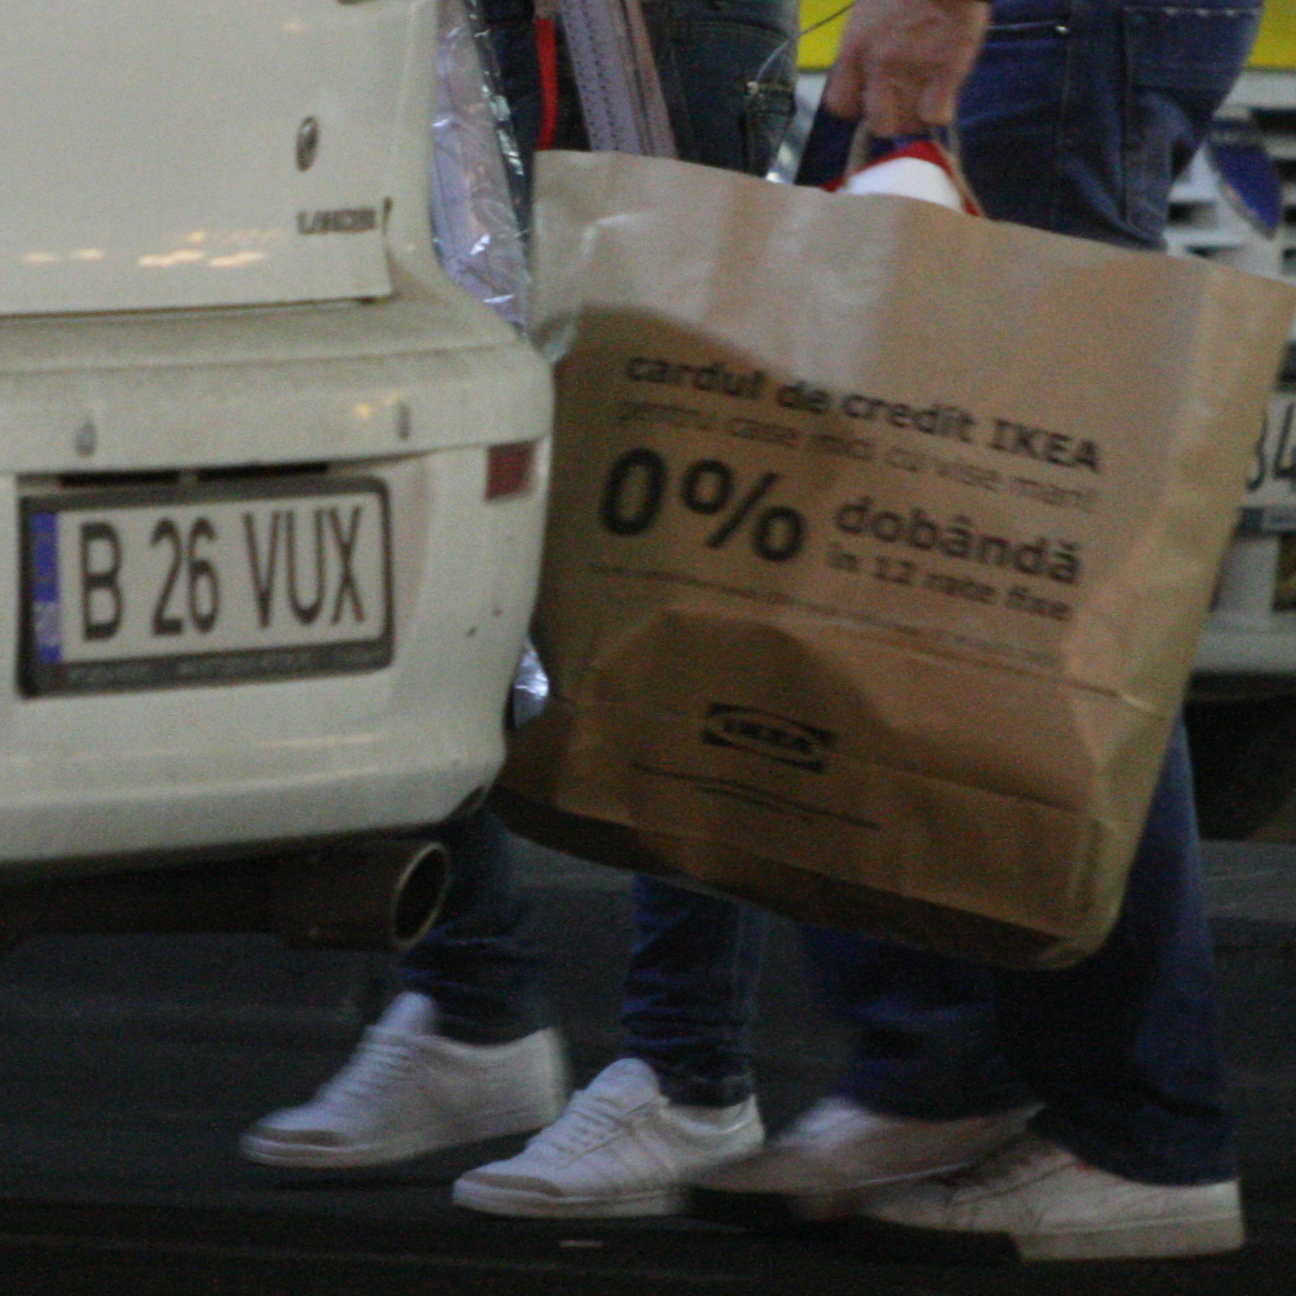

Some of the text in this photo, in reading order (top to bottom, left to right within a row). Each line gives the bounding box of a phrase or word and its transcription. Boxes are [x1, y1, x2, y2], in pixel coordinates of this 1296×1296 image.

[624, 355, 1103, 474] cardul de credit IKEA
[80, 521, 123, 643] B
[150, 516, 221, 636] 26
[243, 505, 368, 630] VUX
[600, 447, 1083, 585] 0% dobândă
[874, 553, 915, 588] 12
[922, 568, 998, 606] rate
[1009, 583, 1074, 623] fixe
